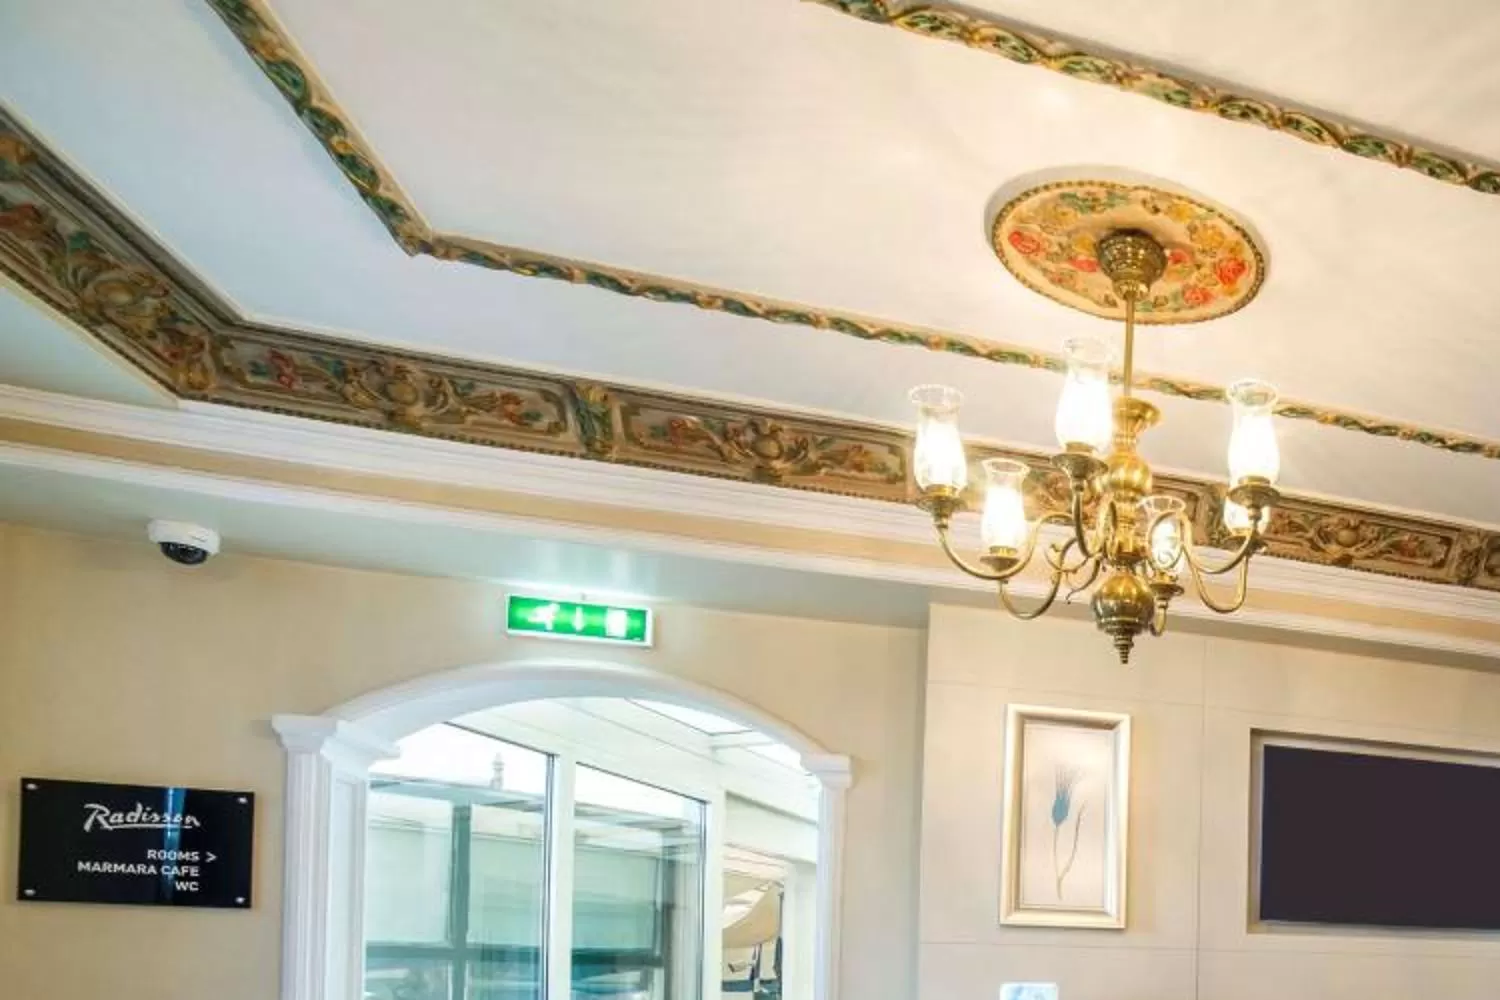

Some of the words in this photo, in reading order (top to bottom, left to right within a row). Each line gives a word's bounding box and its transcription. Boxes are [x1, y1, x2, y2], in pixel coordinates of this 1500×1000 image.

[84, 803, 200, 832] Radisson
[147, 849, 200, 862] ROOMS
[77, 861, 157, 876] MARMARA
[160, 865, 200, 878] CAFE
[175, 880, 200, 892] WC
